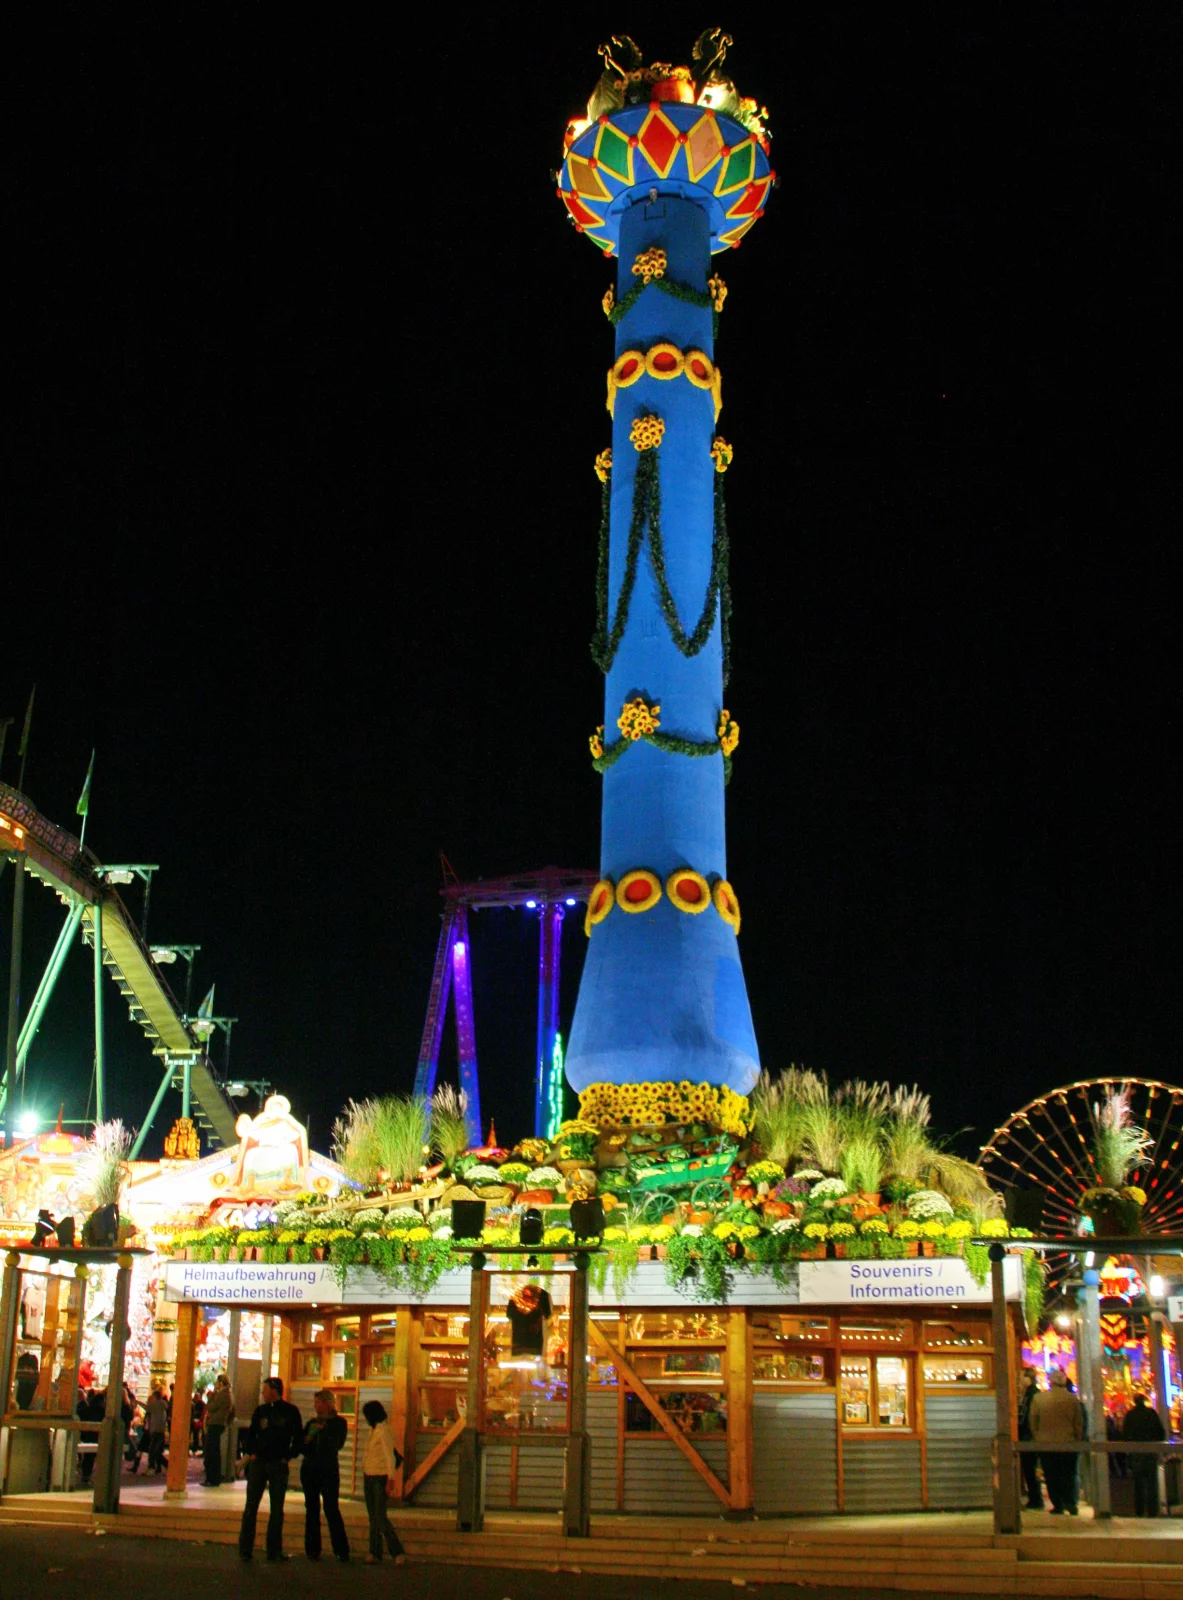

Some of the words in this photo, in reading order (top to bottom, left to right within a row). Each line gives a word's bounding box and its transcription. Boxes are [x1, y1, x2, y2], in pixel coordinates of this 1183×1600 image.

[184, 1268, 316, 1284] Helmaufbewahrung
[850, 1264, 933, 1279] Souvenirs
[183, 1285, 304, 1299] Fundsachenstelle
[850, 1283, 966, 1298] Informationen
